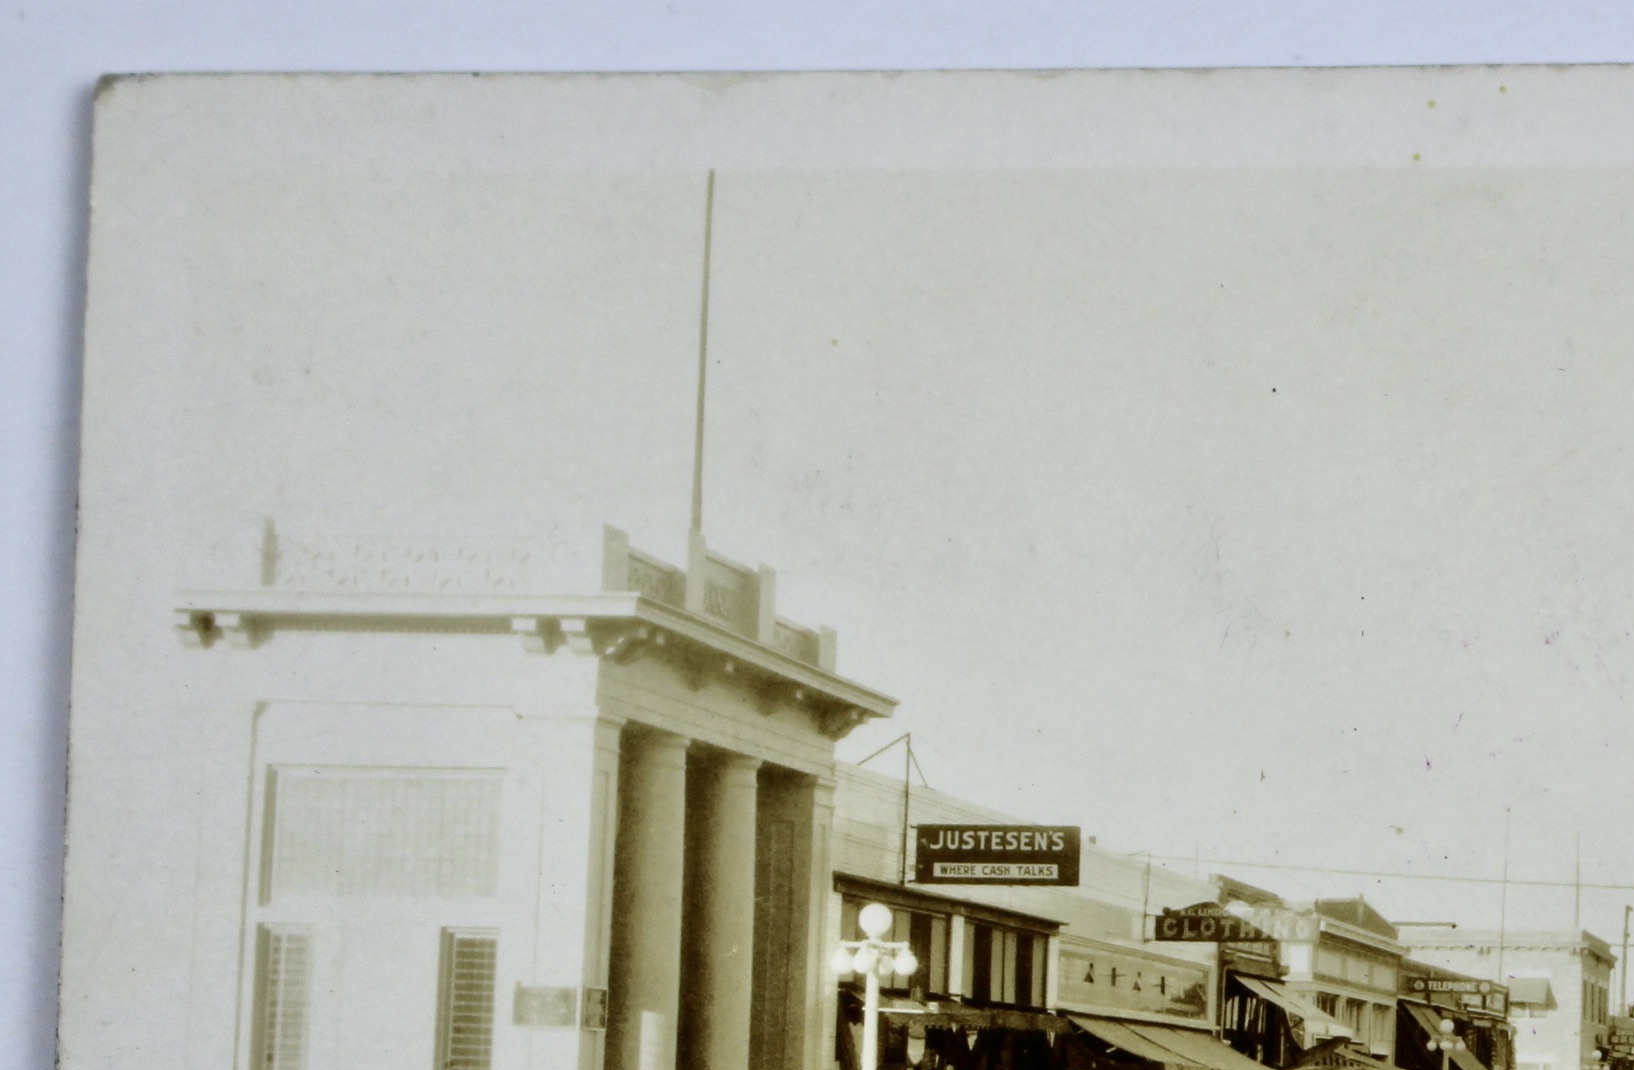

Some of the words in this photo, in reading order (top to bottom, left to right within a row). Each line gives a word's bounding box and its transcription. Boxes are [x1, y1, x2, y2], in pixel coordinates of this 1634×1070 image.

[930, 831, 1065, 850] JUSTESEN'S
[940, 864, 976, 875] WHERE
[982, 865, 1010, 875] CASH
[1017, 865, 1053, 876] TALKS
[1162, 917, 1312, 939] CLOTHING
[1428, 981, 1477, 992] TELEPHONE
